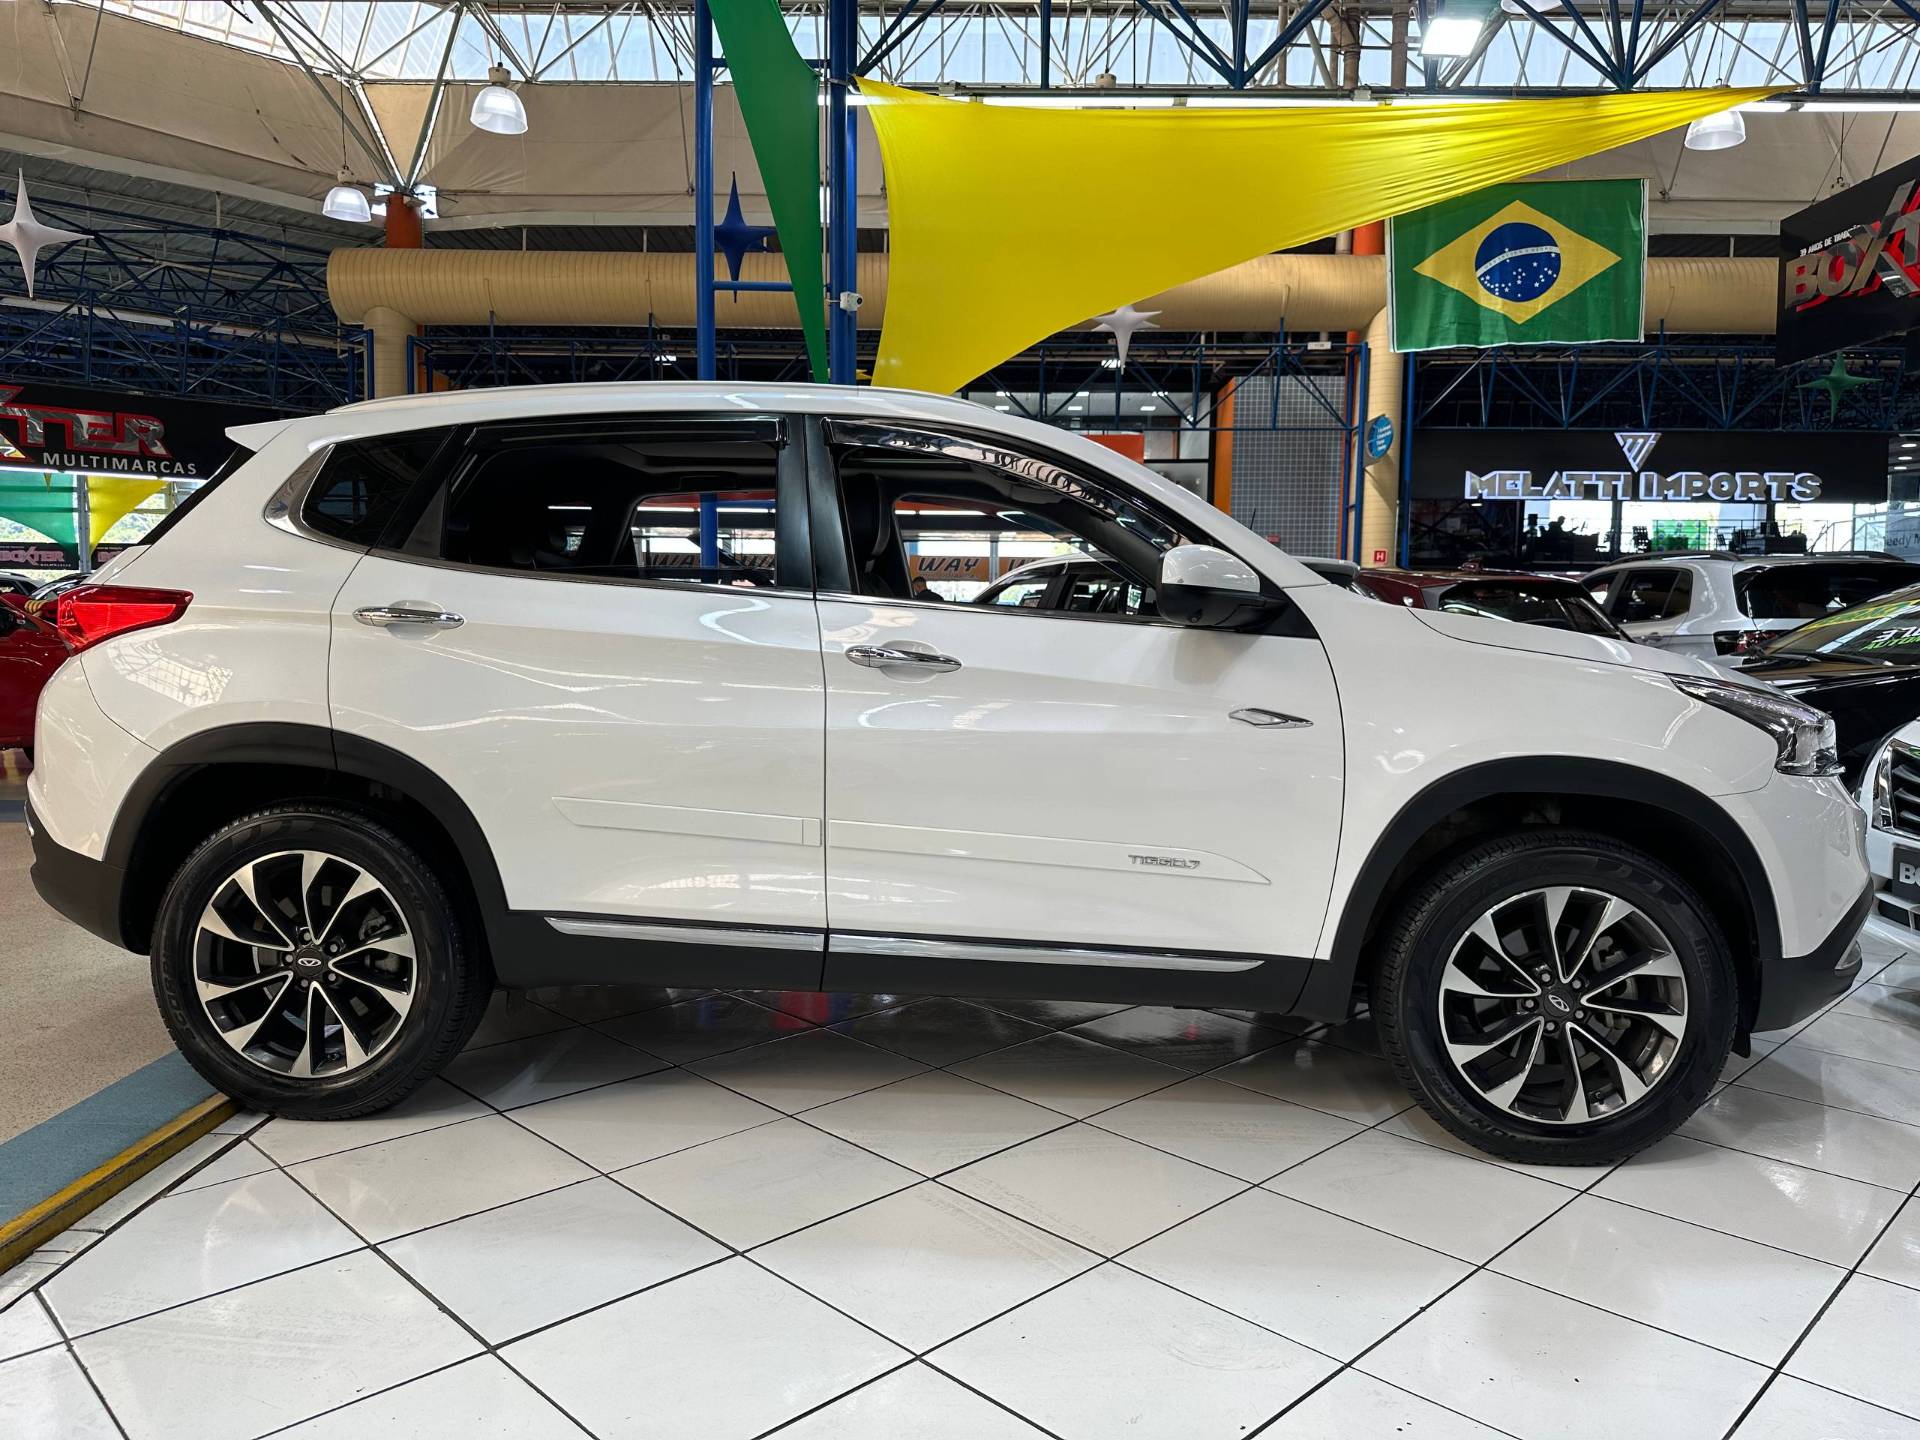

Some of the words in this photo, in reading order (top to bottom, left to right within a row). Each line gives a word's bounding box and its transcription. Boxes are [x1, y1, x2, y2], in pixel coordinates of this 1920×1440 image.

[1824, 236, 1833, 247] DE
[43, 452, 197, 475] MULTIMARCAS
[1464, 470, 1632, 500] MELATTI
[1639, 470, 1823, 501] IMPORTS
[918, 557, 980, 572] WAY
